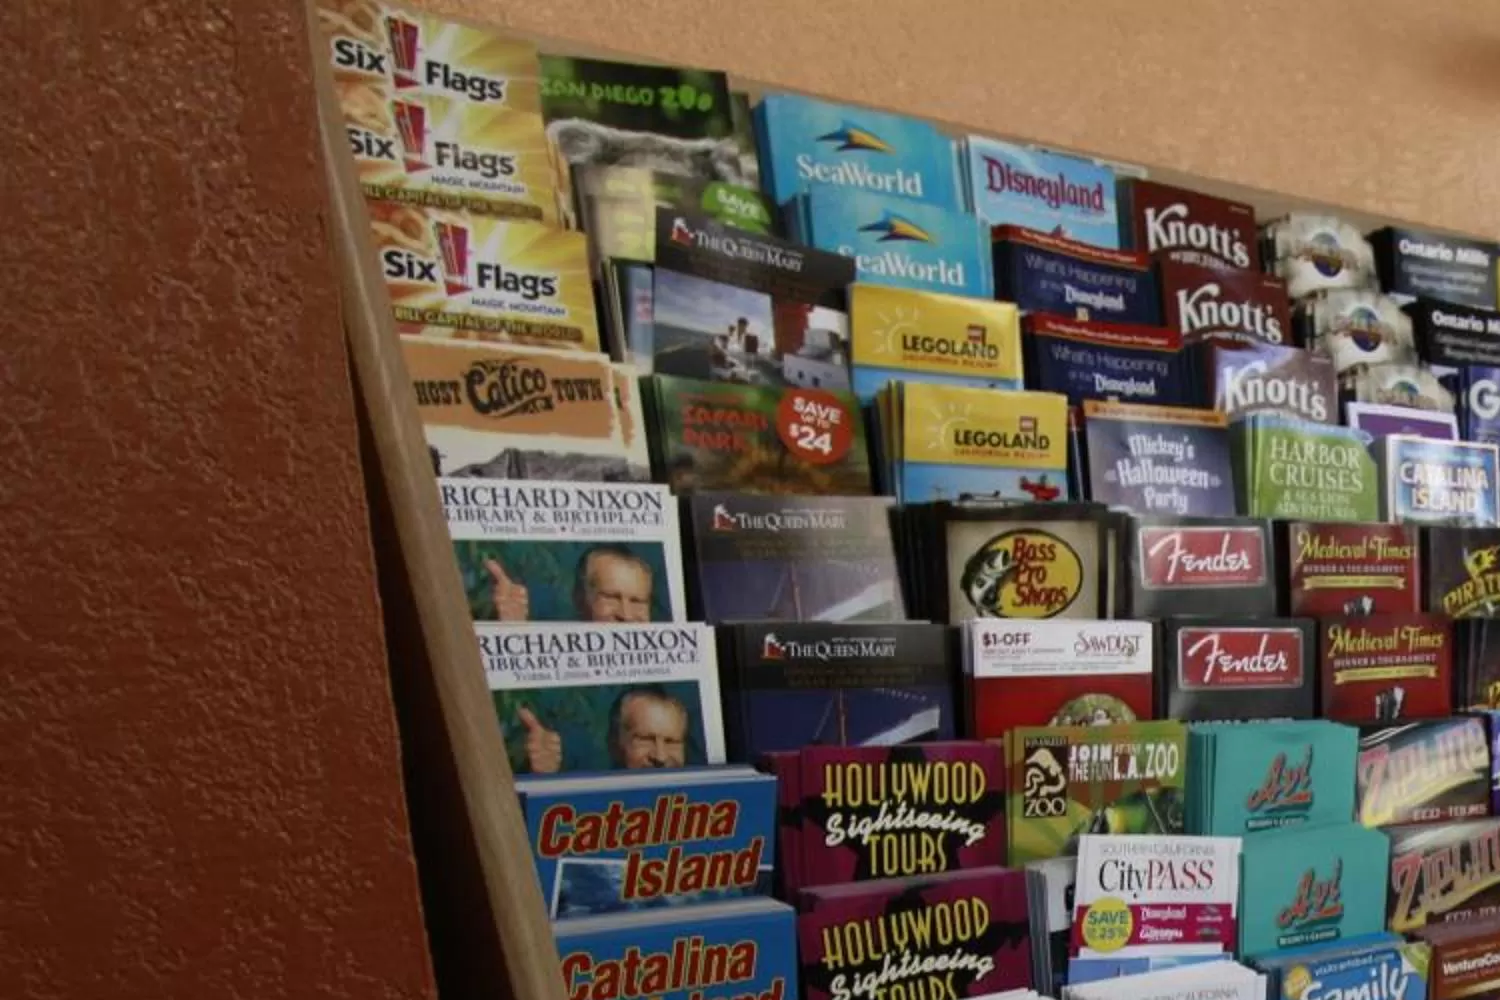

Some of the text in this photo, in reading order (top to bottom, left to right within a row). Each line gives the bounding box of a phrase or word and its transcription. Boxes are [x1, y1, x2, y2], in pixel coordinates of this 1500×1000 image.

[335, 39, 504, 101] Six Flags
[540, 78, 587, 97] SAN
[593, 83, 656, 105] DIEGO
[349, 129, 515, 177] Six Flags
[797, 155, 923, 197] SeaWorld
[982, 156, 1106, 212] Disneyland
[1145, 203, 1250, 268] Knott's
[1400, 239, 1453, 261] Ontario
[1456, 247, 1490, 267] Mills
[384, 251, 557, 300] Six Flags
[1177, 283, 1282, 345] Knott's
[1432, 310, 1485, 333] Ontario
[902, 333, 999, 359] LEGOLAND
[414, 380, 462, 405] HOST
[463, 360, 548, 416] Calico
[552, 378, 604, 402] TOWN
[1223, 360, 1327, 422] Knott's
[793, 397, 842, 425] SAVE
[789, 423, 833, 456] $24
[954, 428, 1051, 451] LEGOLAND
[1128, 434, 1195, 460] Mickey's
[1270, 436, 1361, 469] HARBOR
[1116, 458, 1210, 488] Halloween
[1269, 461, 1364, 494] CRUISES
[442, 485, 664, 512] RICHARD NIXON
[1144, 490, 1190, 516] Party
[532, 510, 546, 524] &
[553, 510, 665, 527] BIRTHPLACE
[1013, 537, 1056, 562] Bass
[1149, 531, 1252, 582] Fender
[1297, 530, 1415, 563] Medieval Times
[1012, 560, 1047, 584] Pro
[1012, 583, 1069, 612] Shops
[478, 627, 699, 658] RICHARD NIXON
[815, 641, 859, 662] QUEEN
[861, 643, 897, 658] MARY
[1187, 632, 1289, 684] Fender
[1328, 624, 1444, 659] Medieval Times
[486, 649, 700, 673] IBRARY & BIRTHPLACE
[1069, 742, 1113, 762] JOIN
[1146, 742, 1179, 778] ZOO
[822, 761, 987, 809] HOLLYWOOD
[1025, 797, 1067, 817] ZOO
[538, 792, 740, 859] Catalina
[826, 801, 986, 847] Sightseeing
[623, 836, 765, 900] Island
[867, 831, 948, 877] TOURS
[1099, 857, 1215, 899] CityPASS
[821, 896, 990, 971] HOLLYWOOD
